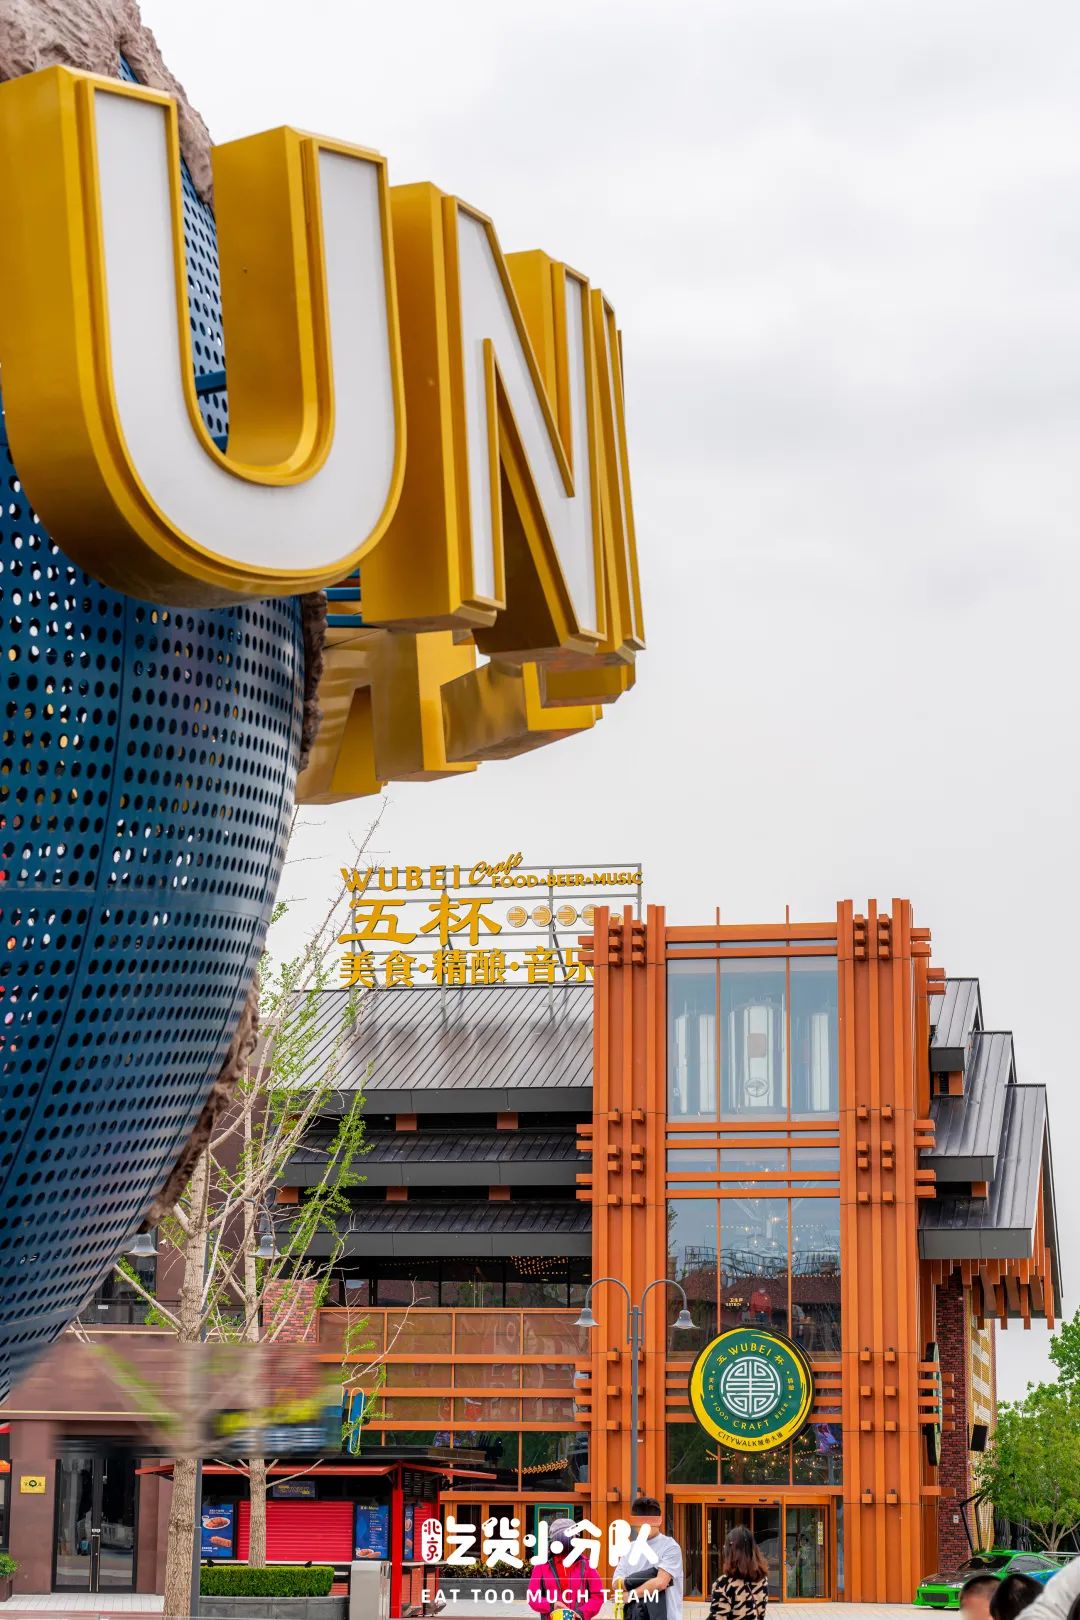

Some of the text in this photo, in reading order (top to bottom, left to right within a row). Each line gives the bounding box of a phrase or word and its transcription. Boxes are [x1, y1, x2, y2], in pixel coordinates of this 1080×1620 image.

[340, 852, 523, 892] WUBEI Craft
[337, 893, 503, 946] 五杯
[716, 1342, 785, 1366] 五 WUBEI 杯
[712, 1402, 729, 1421] FOOD
[732, 1419, 770, 1431] CRAFT
